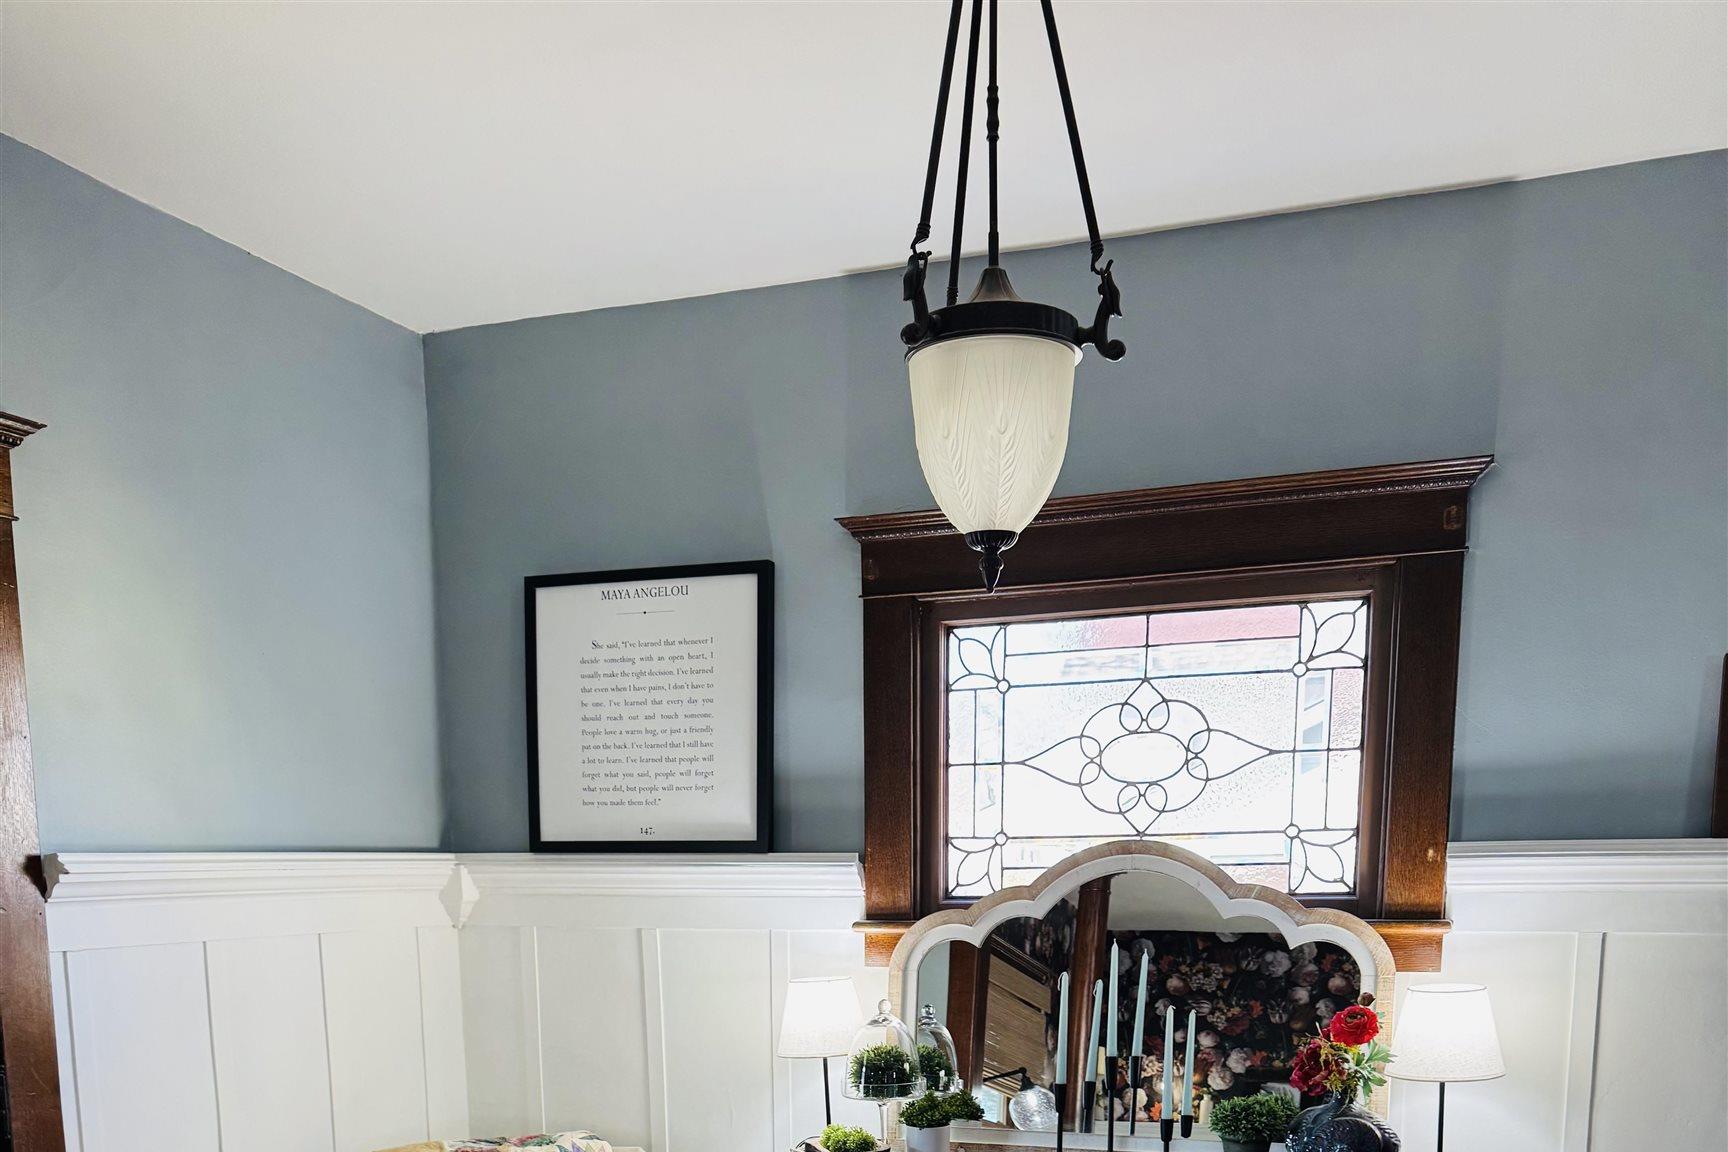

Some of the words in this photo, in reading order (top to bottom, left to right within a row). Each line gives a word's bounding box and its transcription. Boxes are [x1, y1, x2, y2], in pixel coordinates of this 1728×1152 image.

[601, 588, 631, 601] MAYA
[633, 585, 689, 599] ANGELOU
[592, 641, 604, 649] She
[638, 639, 661, 648] learned
[604, 657, 635, 665] something
[632, 670, 647, 678] right
[582, 729, 602, 739] People
[670, 727, 681, 735] just
[689, 726, 713, 735] friendly
[679, 756, 700, 764] people
[582, 772, 600, 781] forget
[655, 770, 676, 779] people
[639, 784, 659, 793] people
[695, 784, 713, 793] forget
